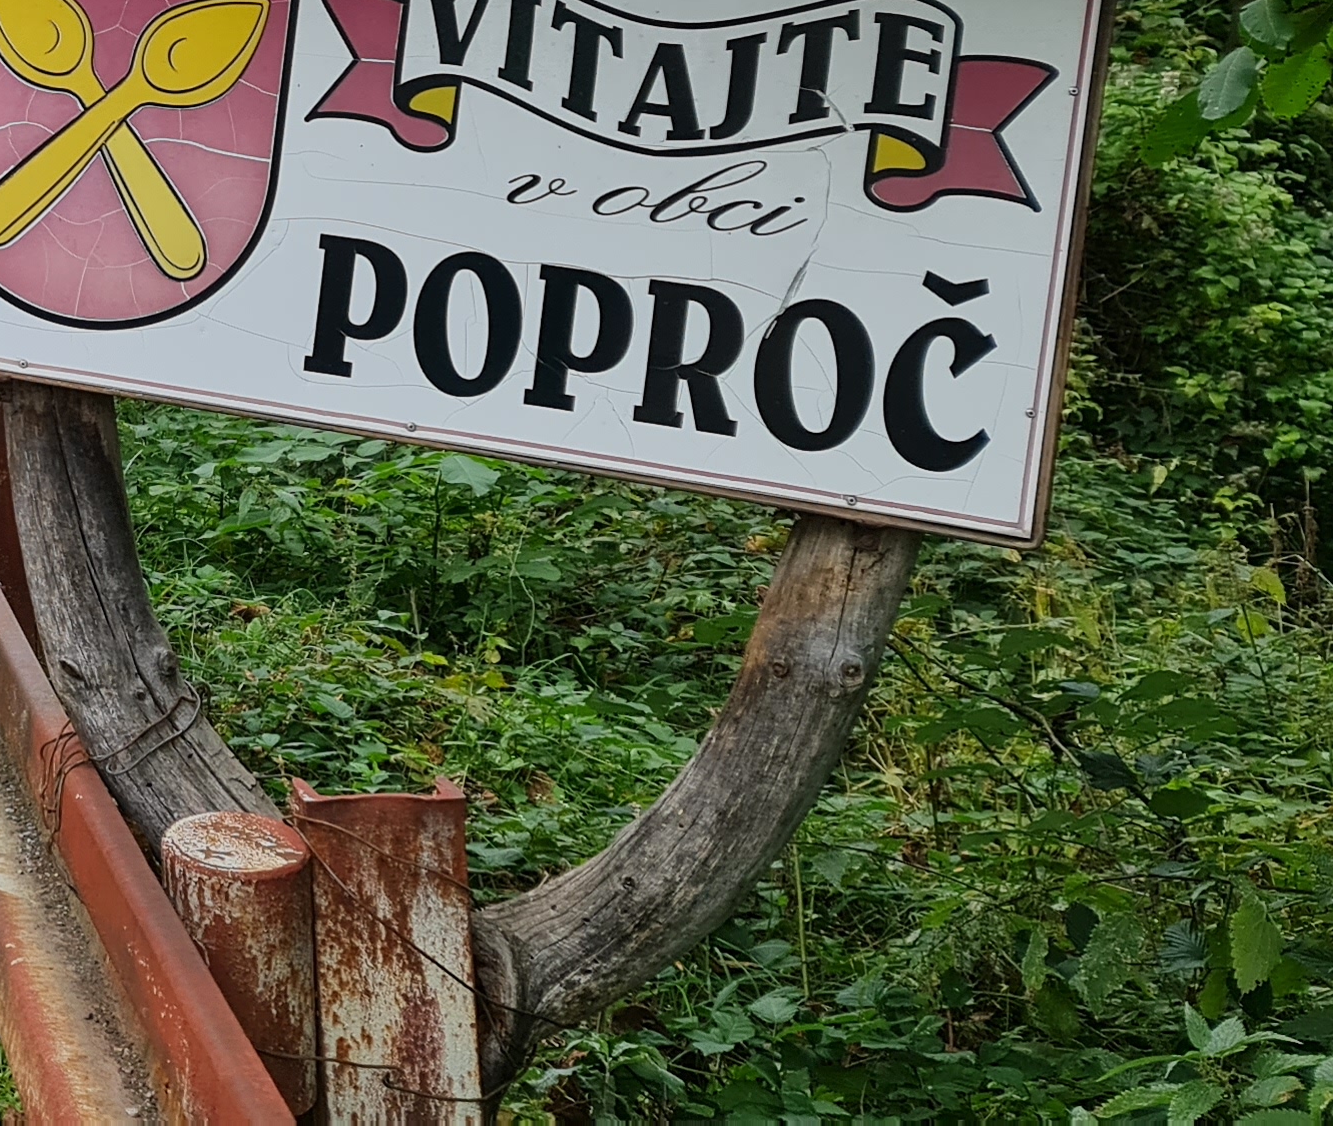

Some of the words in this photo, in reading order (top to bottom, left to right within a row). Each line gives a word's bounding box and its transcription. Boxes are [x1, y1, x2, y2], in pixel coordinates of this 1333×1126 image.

[506, 173, 577, 205] v
[592, 160, 808, 236] obci
[303, 233, 998, 473] POPROČ
